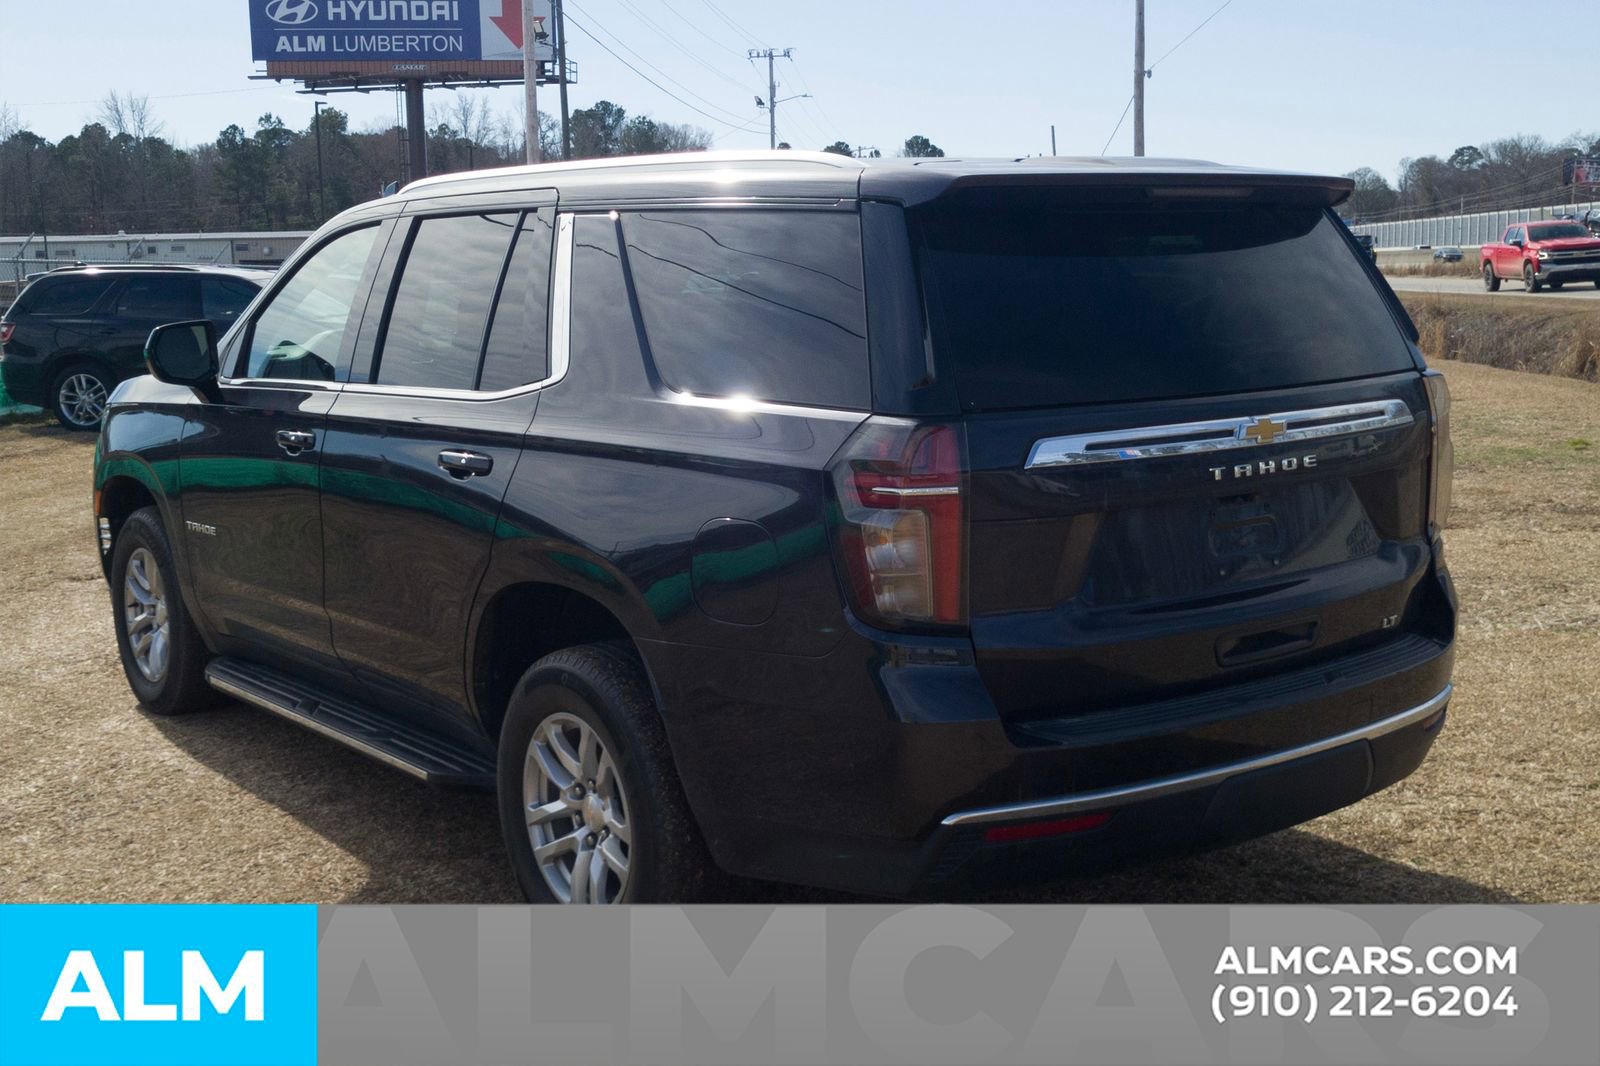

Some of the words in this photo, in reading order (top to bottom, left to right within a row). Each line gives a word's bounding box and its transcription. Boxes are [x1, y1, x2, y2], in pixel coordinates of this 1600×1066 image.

[327, 0, 459, 21] HYUNDAI
[275, 35, 326, 52] ALM
[333, 35, 463, 52] LUMBERTON
[1208, 454, 1318, 481] TAHOE
[185, 520, 217, 536] TAHOE
[1383, 614, 1398, 628] LT
